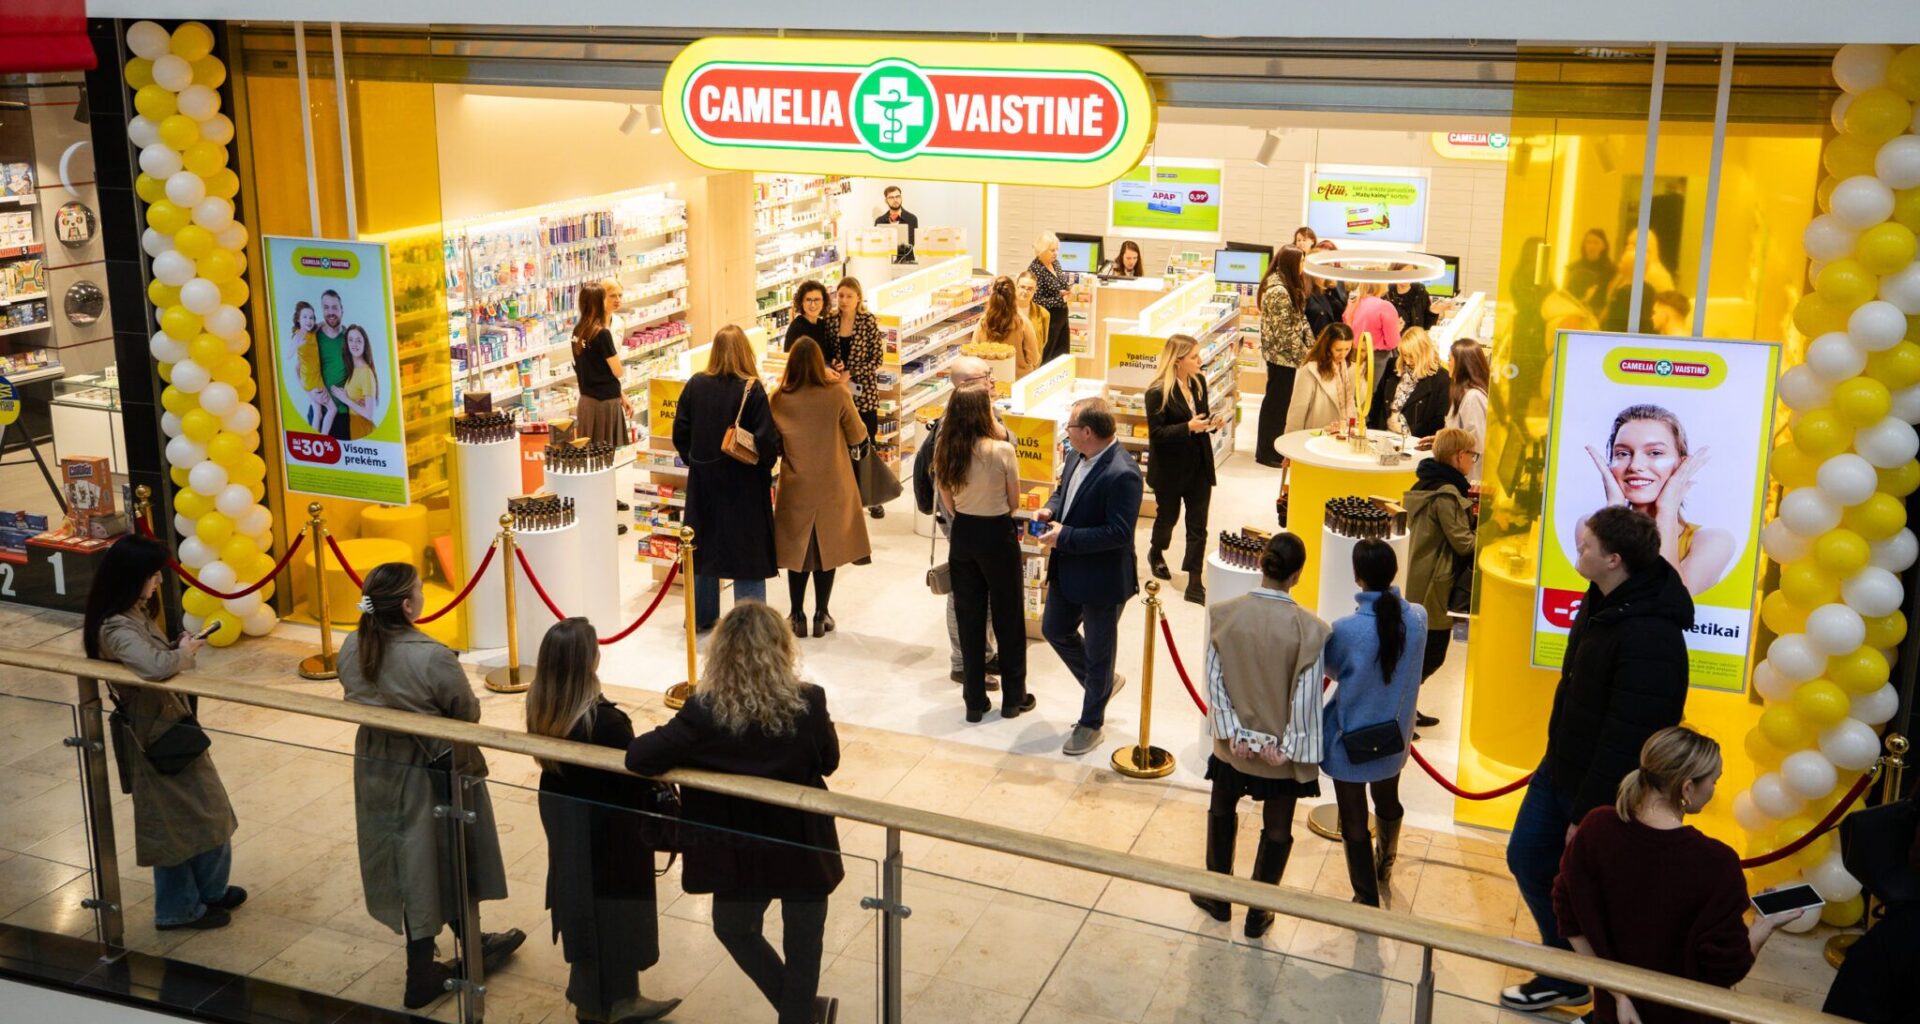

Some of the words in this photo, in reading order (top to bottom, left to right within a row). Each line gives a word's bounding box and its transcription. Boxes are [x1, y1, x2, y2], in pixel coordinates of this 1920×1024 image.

[699, 84, 844, 127] CAMELIA
[944, 93, 1104, 137] VAISTINĖ
[1449, 132, 1488, 144] CAMELIA
[1152, 191, 1176, 201] APAP
[1126, 352, 1157, 362] Ypatingi
[1621, 361, 1654, 371] CAMELIA
[1674, 364, 1707, 375] VAISTINĖ
[662, 399, 678, 408] AKT
[660, 410, 675, 419] PAS
[1017, 436, 1039, 448] ALŪS
[343, 443, 379, 456] Visoms
[1015, 449, 1042, 461] LYMAI
[344, 455, 388, 468] prekėms
[0, 562, 17, 597] 2
[47, 551, 67, 596] 1
[1554, 599, 1583, 621] -2
[1684, 622, 1740, 639] etikai
